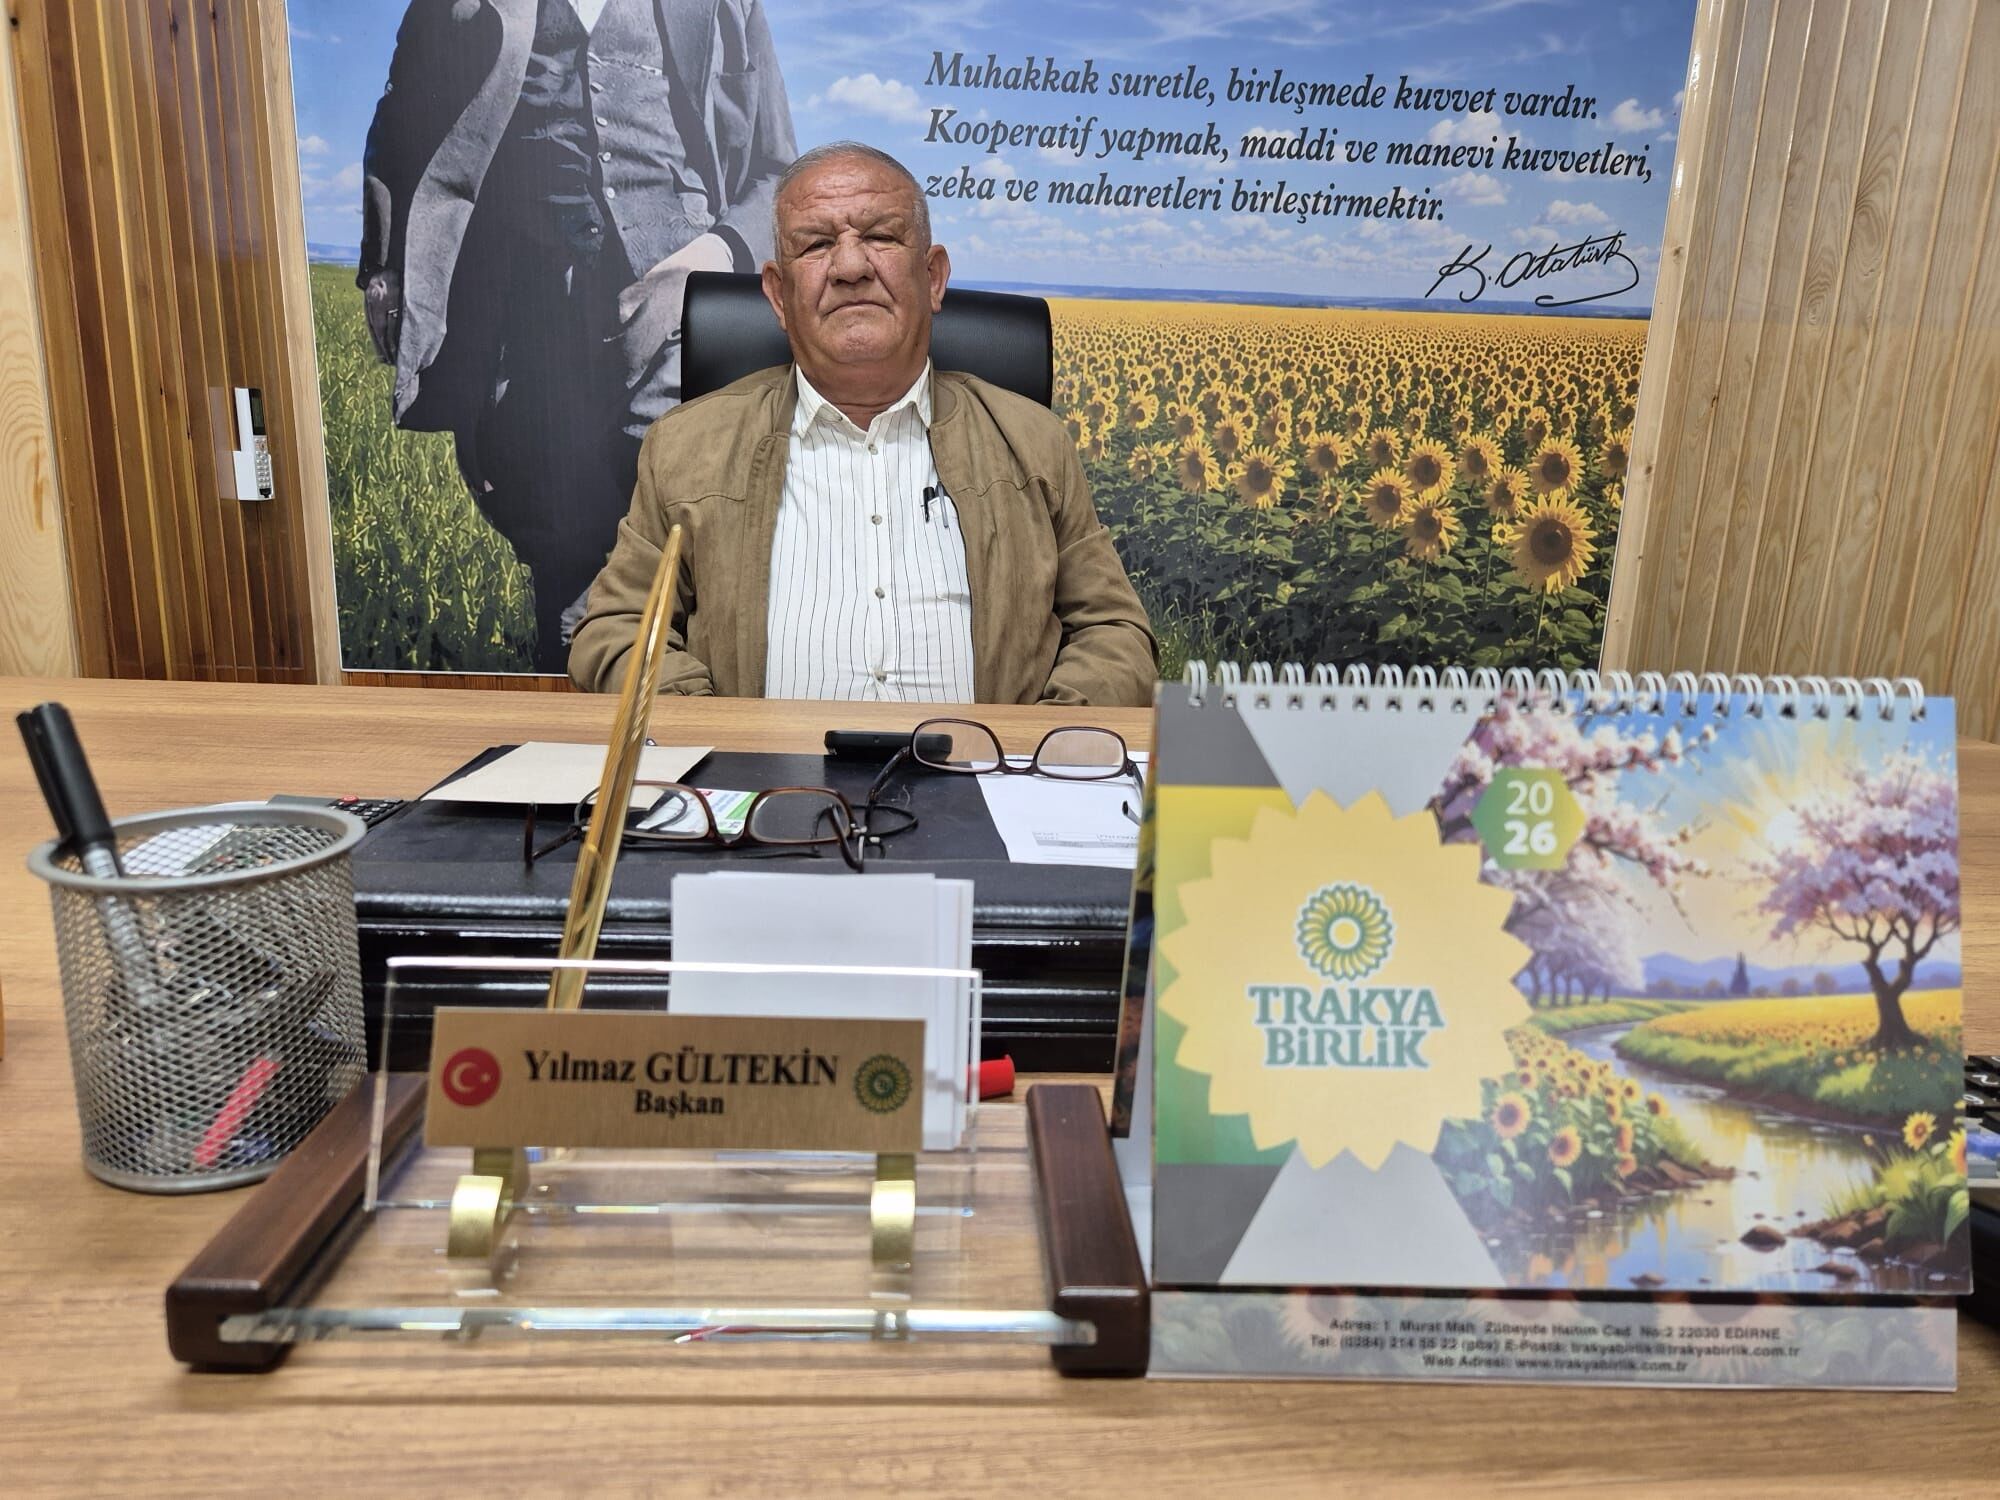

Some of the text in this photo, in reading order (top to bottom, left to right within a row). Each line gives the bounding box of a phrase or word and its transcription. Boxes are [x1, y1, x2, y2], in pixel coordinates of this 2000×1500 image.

[924, 51, 1597, 119] Muhakkak suretle, birleşmede kuvvet vardır.
[923, 108, 1651, 183] Kooperatif yapmak, maddi ve manevi kuvvetleri,
[926, 166, 1444, 224] zeka ve maharetleri birleştirmektir.
[1505, 780, 1553, 816] 20
[1503, 820, 1558, 856] 26
[1248, 986, 1445, 1027] TRAKYA
[524, 1046, 839, 1086] Yılmaz GÜLTEKİN
[634, 1089, 725, 1119] Başkan
